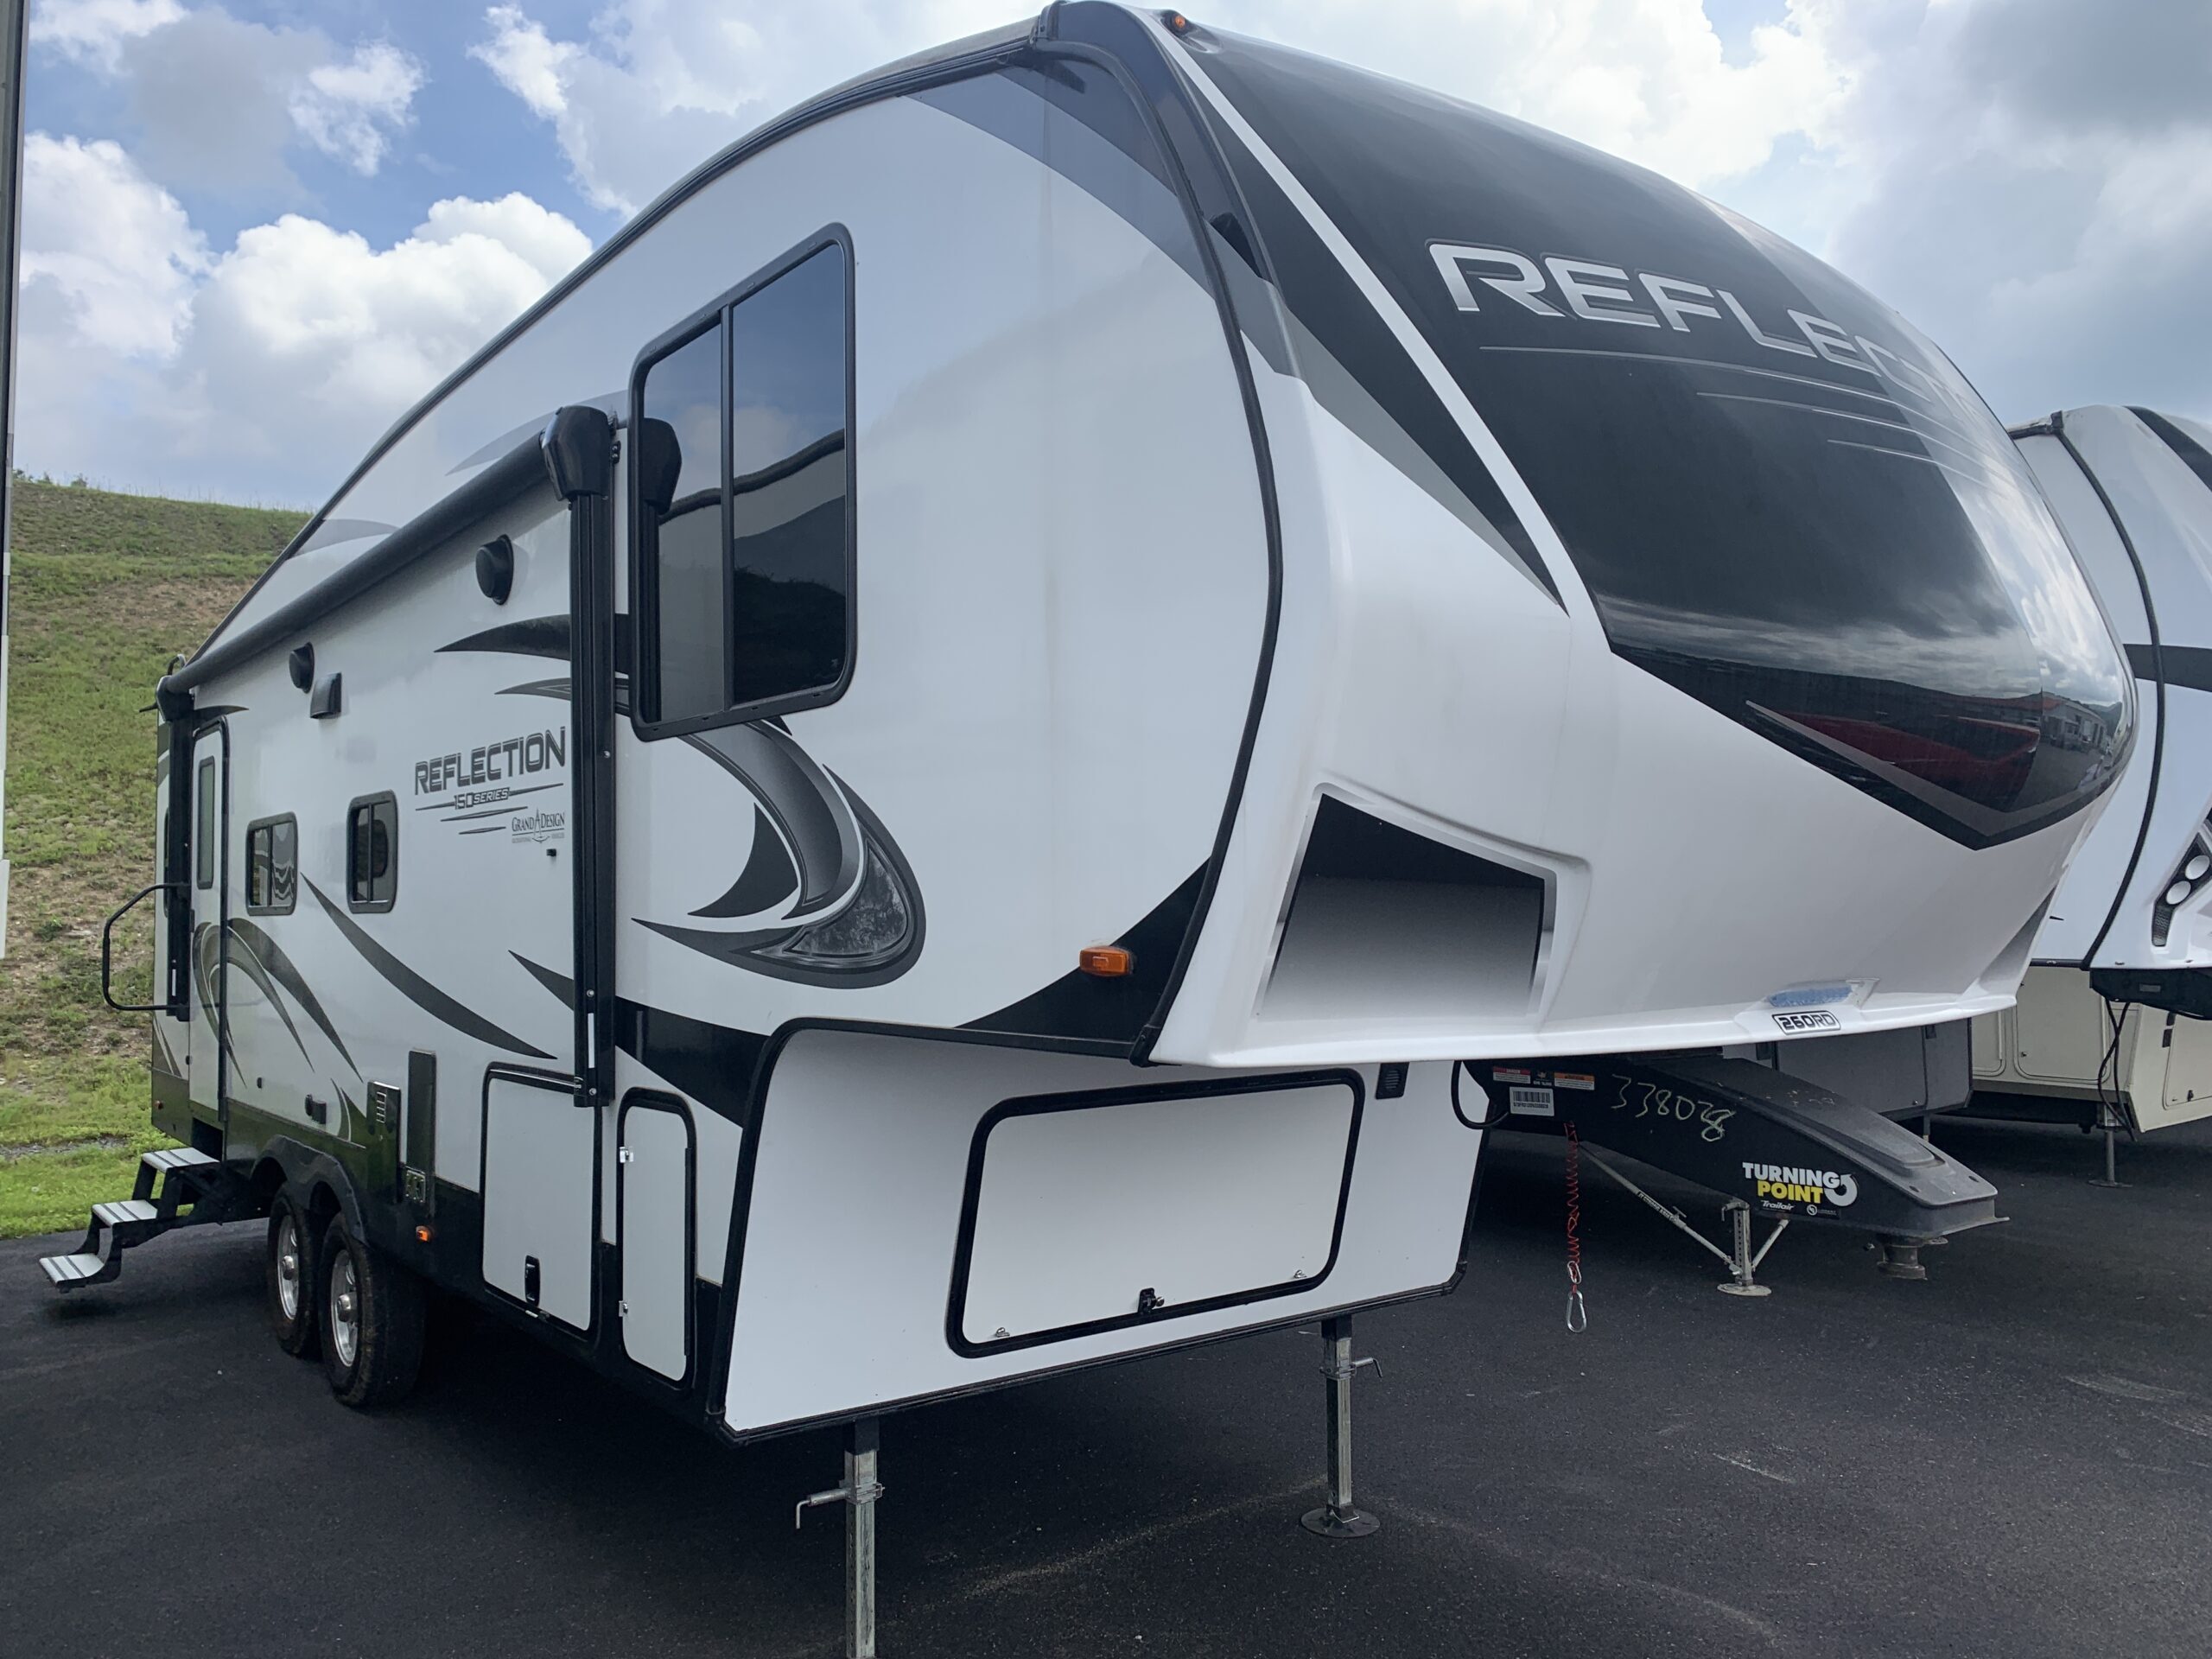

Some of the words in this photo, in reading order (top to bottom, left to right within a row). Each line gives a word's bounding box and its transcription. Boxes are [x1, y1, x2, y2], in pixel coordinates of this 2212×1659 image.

[1427, 239, 1972, 427] REFLECT
[415, 726, 565, 795] REFLECTION
[512, 817, 534, 832] GRAND
[541, 812, 565, 829] DESIGN
[1777, 1013, 1836, 1030] 260RD
[1742, 1161, 1841, 1189] TURNING
[1757, 1180, 1824, 1204] POINT
[1761, 1200, 1795, 1211] Trailair
